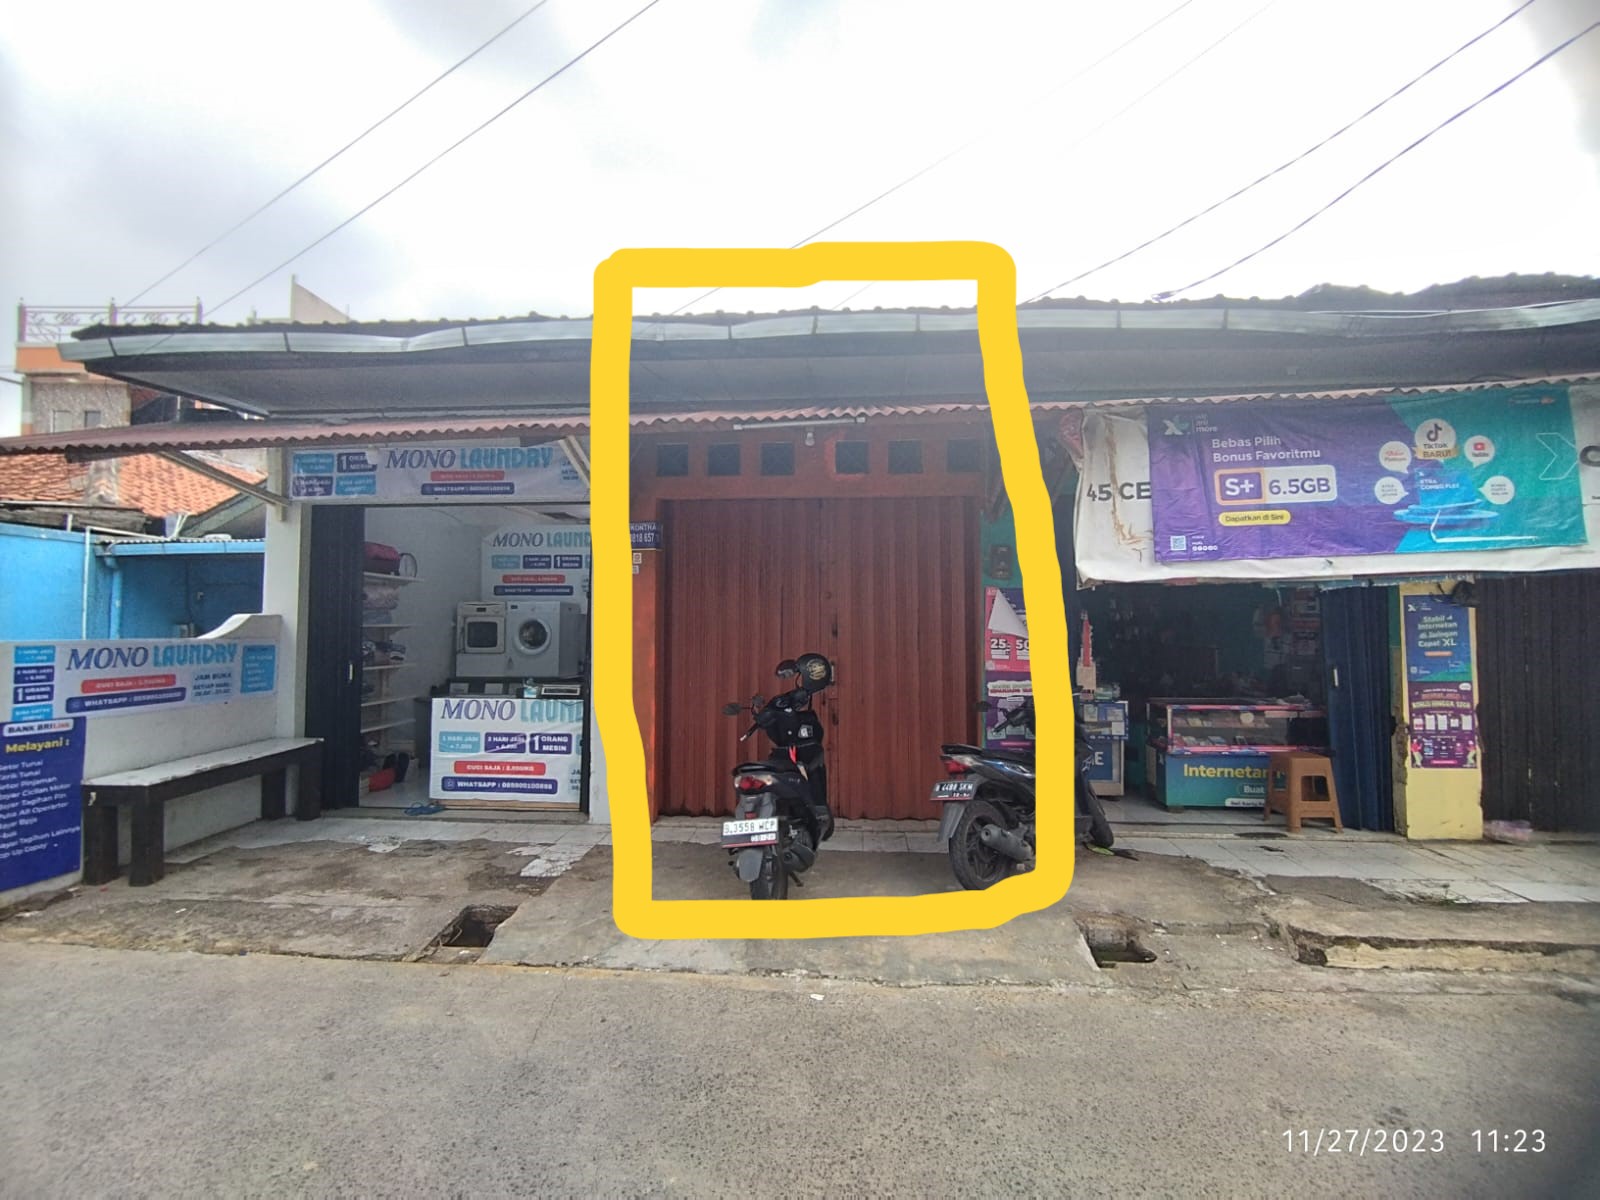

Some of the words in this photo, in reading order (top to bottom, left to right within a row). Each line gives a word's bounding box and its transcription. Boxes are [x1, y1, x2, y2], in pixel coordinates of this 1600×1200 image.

[1212, 437, 1252, 449] Bebas
[1254, 435, 1281, 447] Pilih
[385, 449, 457, 469] MONO
[460, 447, 554, 469] LAUNDRY
[1213, 451, 1252, 463] Bonus
[1255, 449, 1321, 461] Favoritmu
[1086, 483, 1113, 501] 45
[1225, 477, 1254, 496] S+
[1268, 477, 1331, 496] 6.5GB
[1225, 514, 1262, 523] Dapatkan
[493, 532, 544, 548] MONO
[1442, 638, 1457, 647] XL
[66, 646, 149, 670] MONO
[153, 642, 237, 667] LAUNDRY
[84, 696, 128, 707] WHATSAPP
[440, 699, 516, 721] MONO
[8, 726, 35, 734] BANK
[5, 736, 63, 753] Melayani
[540, 735, 568, 743] ORANG
[21, 760, 44, 768] Tunai
[19, 769, 41, 778] Tunai
[1243, 785, 1265, 794] Buat
